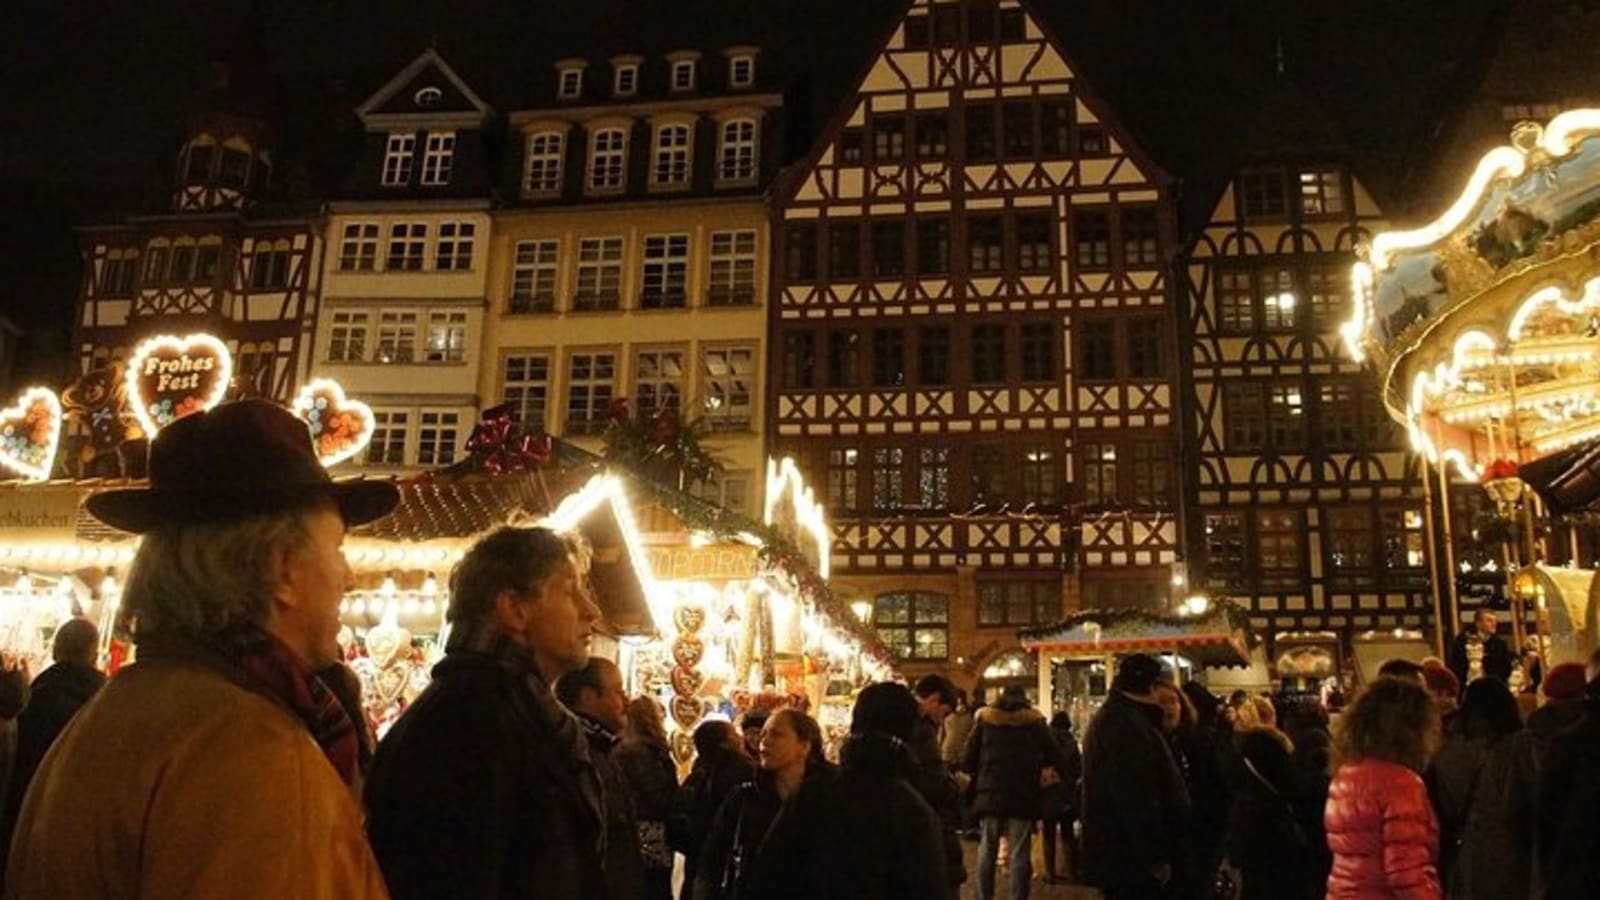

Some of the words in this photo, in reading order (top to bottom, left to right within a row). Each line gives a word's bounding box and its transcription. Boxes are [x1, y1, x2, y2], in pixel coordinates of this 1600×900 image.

[144, 355, 214, 375] Frohes
[157, 373, 199, 392] Fest
[652, 549, 757, 578] OPCORN
